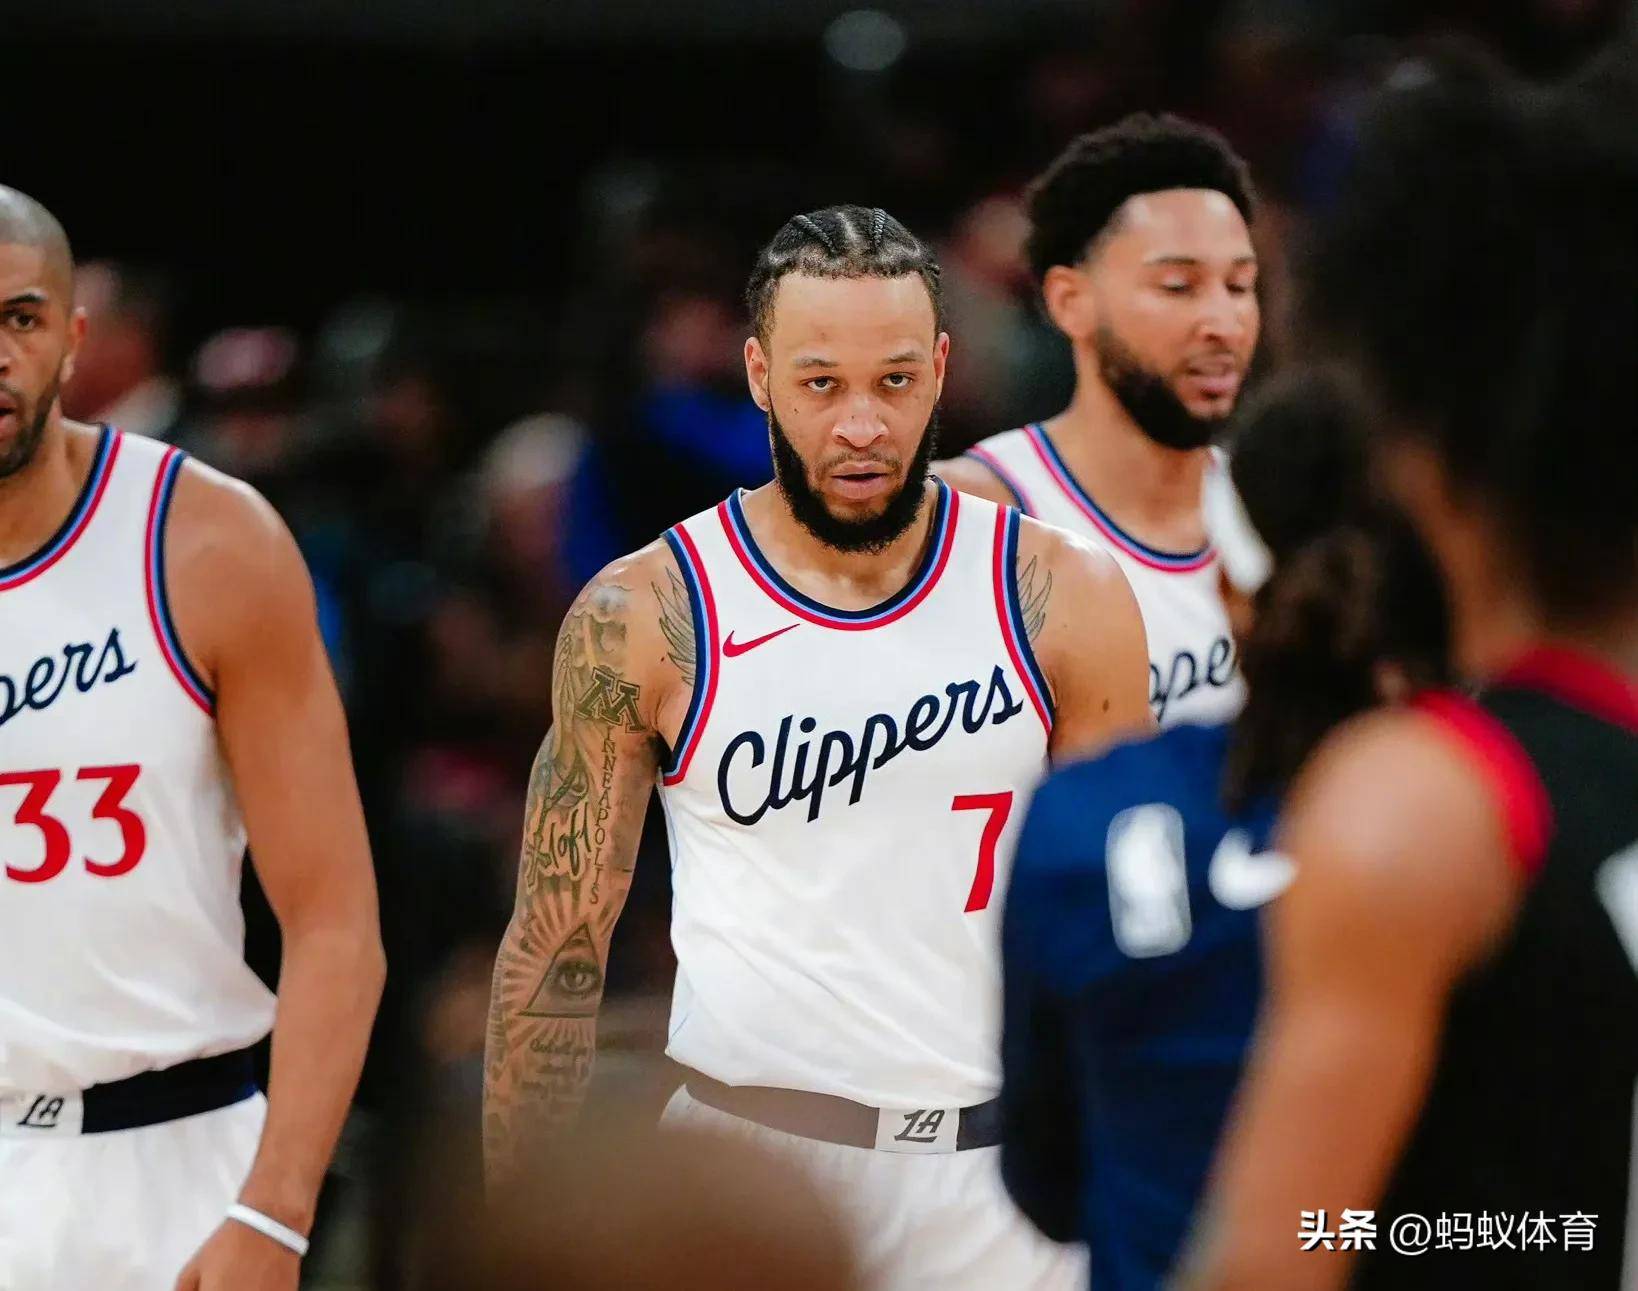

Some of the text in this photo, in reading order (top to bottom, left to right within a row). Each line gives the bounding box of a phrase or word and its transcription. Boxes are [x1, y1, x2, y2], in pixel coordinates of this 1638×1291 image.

[717, 665, 1023, 825] Clippers
[0, 764, 146, 882] 33
[951, 791, 1013, 912] 7
[17, 1094, 65, 1127] LA
[894, 1109, 945, 1143] LA
